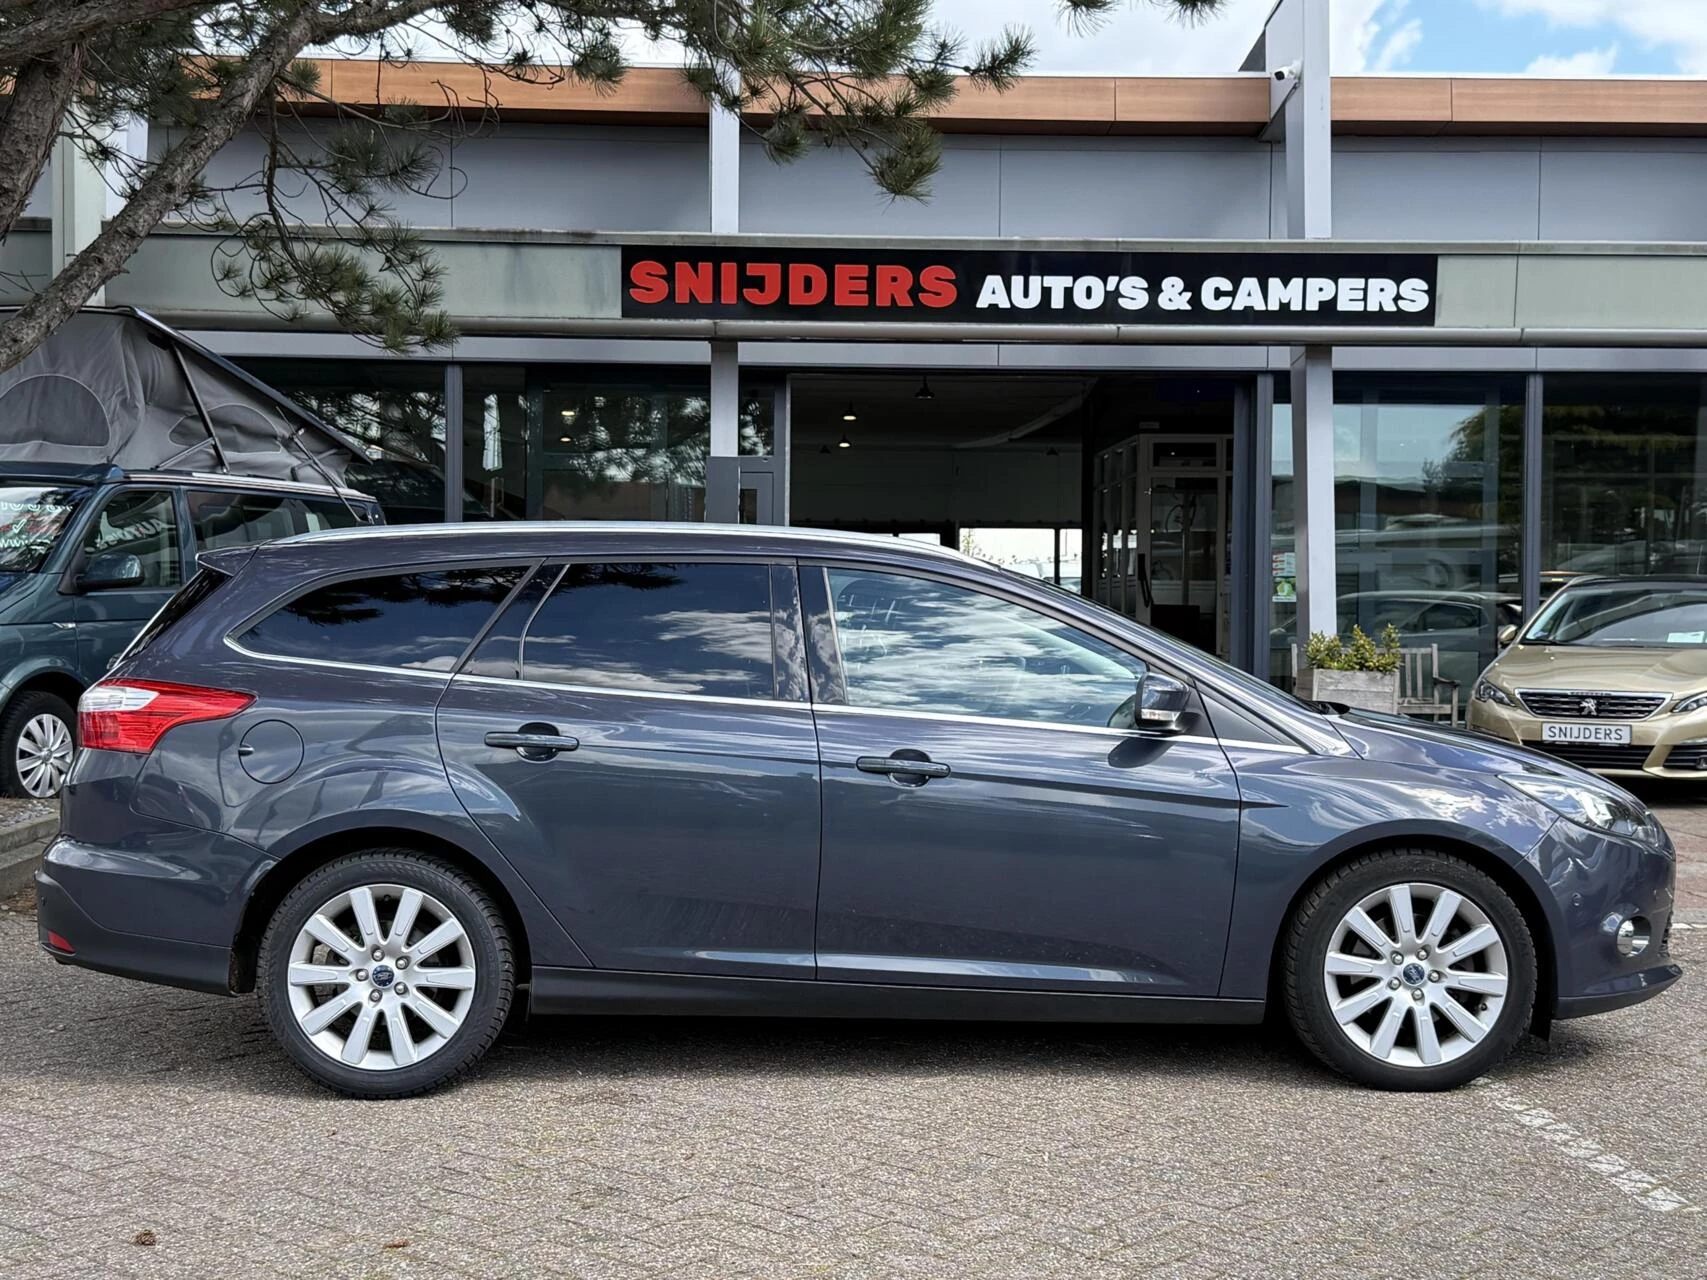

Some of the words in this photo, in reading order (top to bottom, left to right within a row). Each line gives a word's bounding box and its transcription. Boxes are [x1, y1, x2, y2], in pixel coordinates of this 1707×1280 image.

[630, 261, 958, 309] SNIJDERS
[976, 276, 1150, 311] AUTO'S
[1158, 277, 1193, 312] &
[1202, 277, 1430, 314] CAMPERS
[1548, 725, 1623, 741] SNIJDERS
